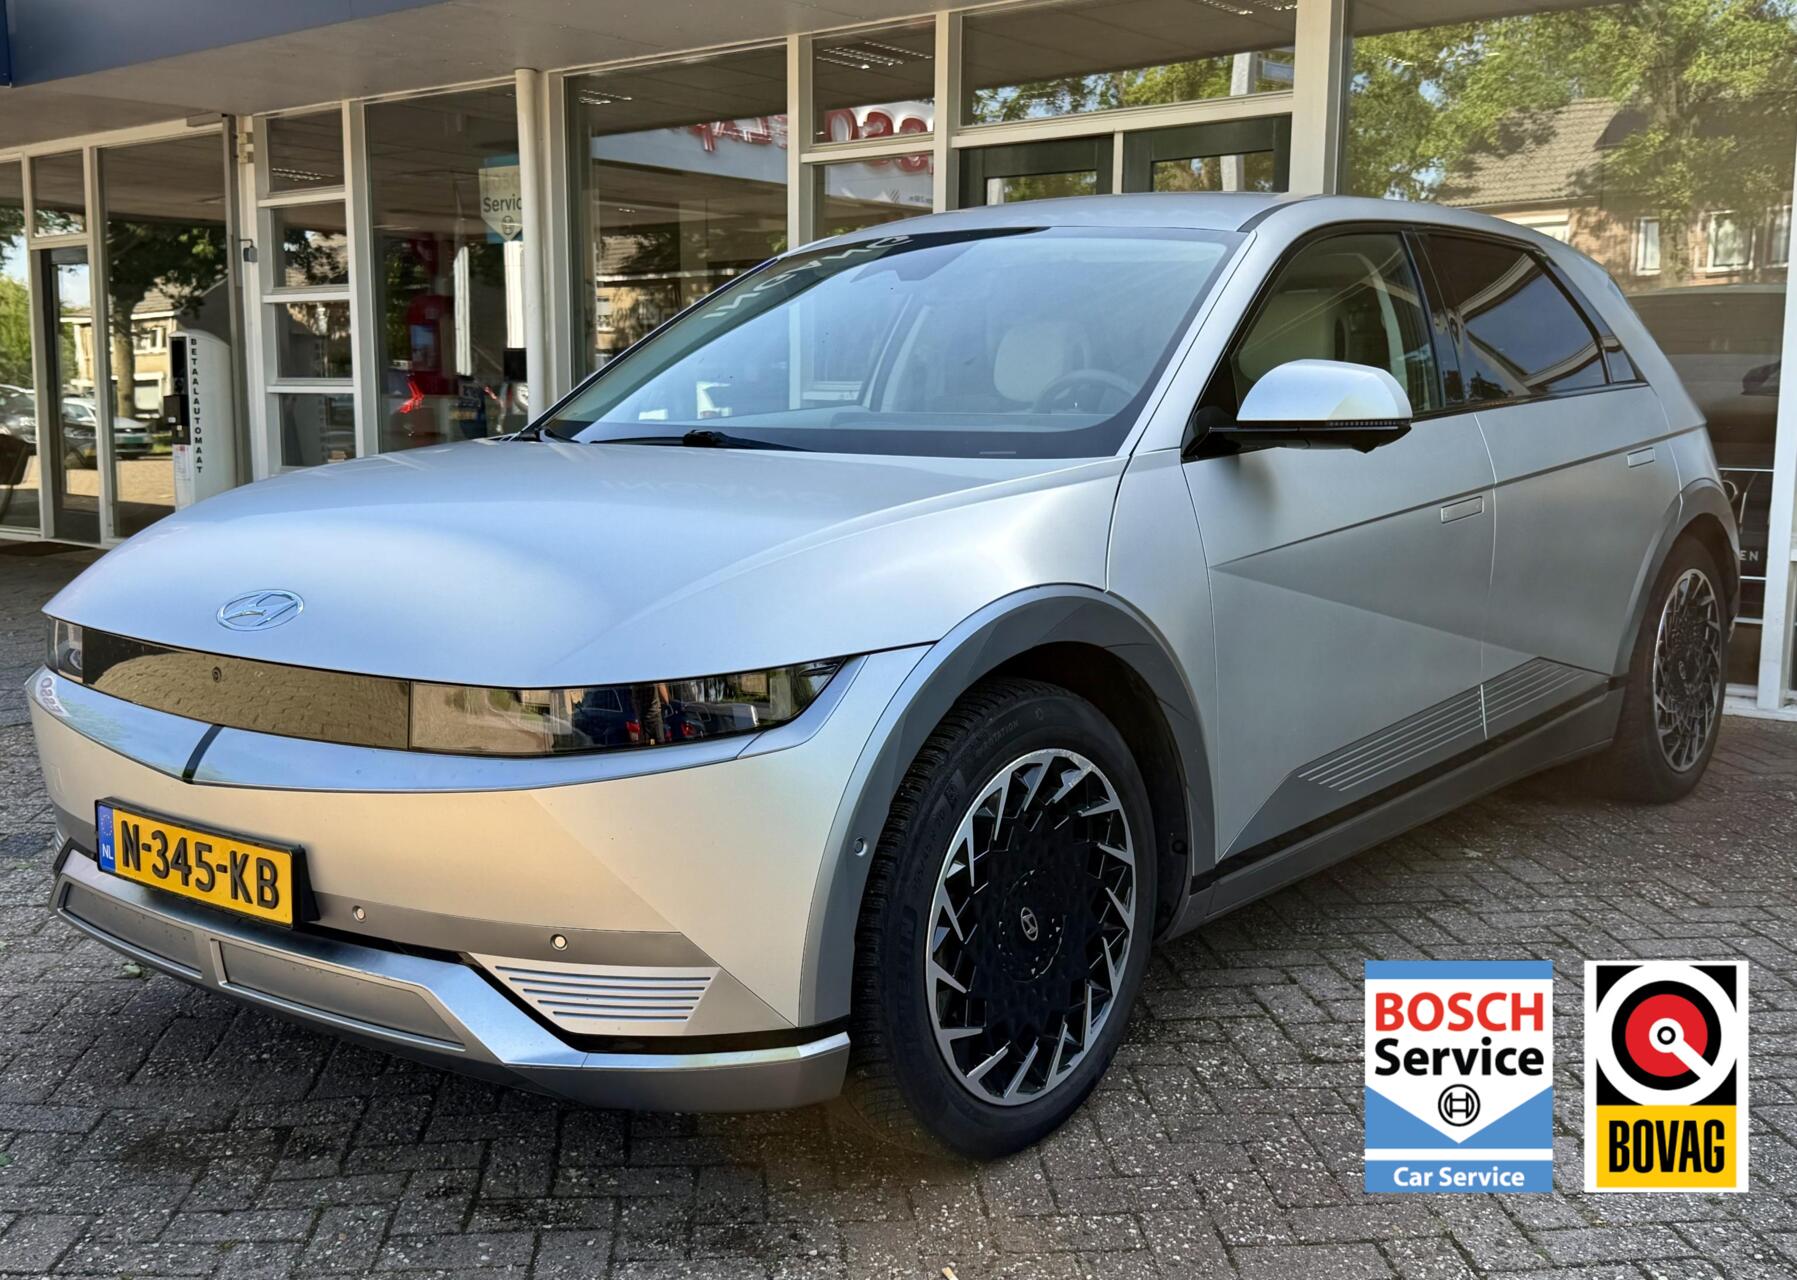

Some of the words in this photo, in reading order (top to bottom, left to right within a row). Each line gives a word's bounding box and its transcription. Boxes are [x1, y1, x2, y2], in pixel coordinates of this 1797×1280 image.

[483, 193, 522, 213] Servic
[190, 338, 203, 474] BETAALAUTOMAAT
[102, 844, 114, 860] NL
[121, 820, 279, 910] N-345-KB
